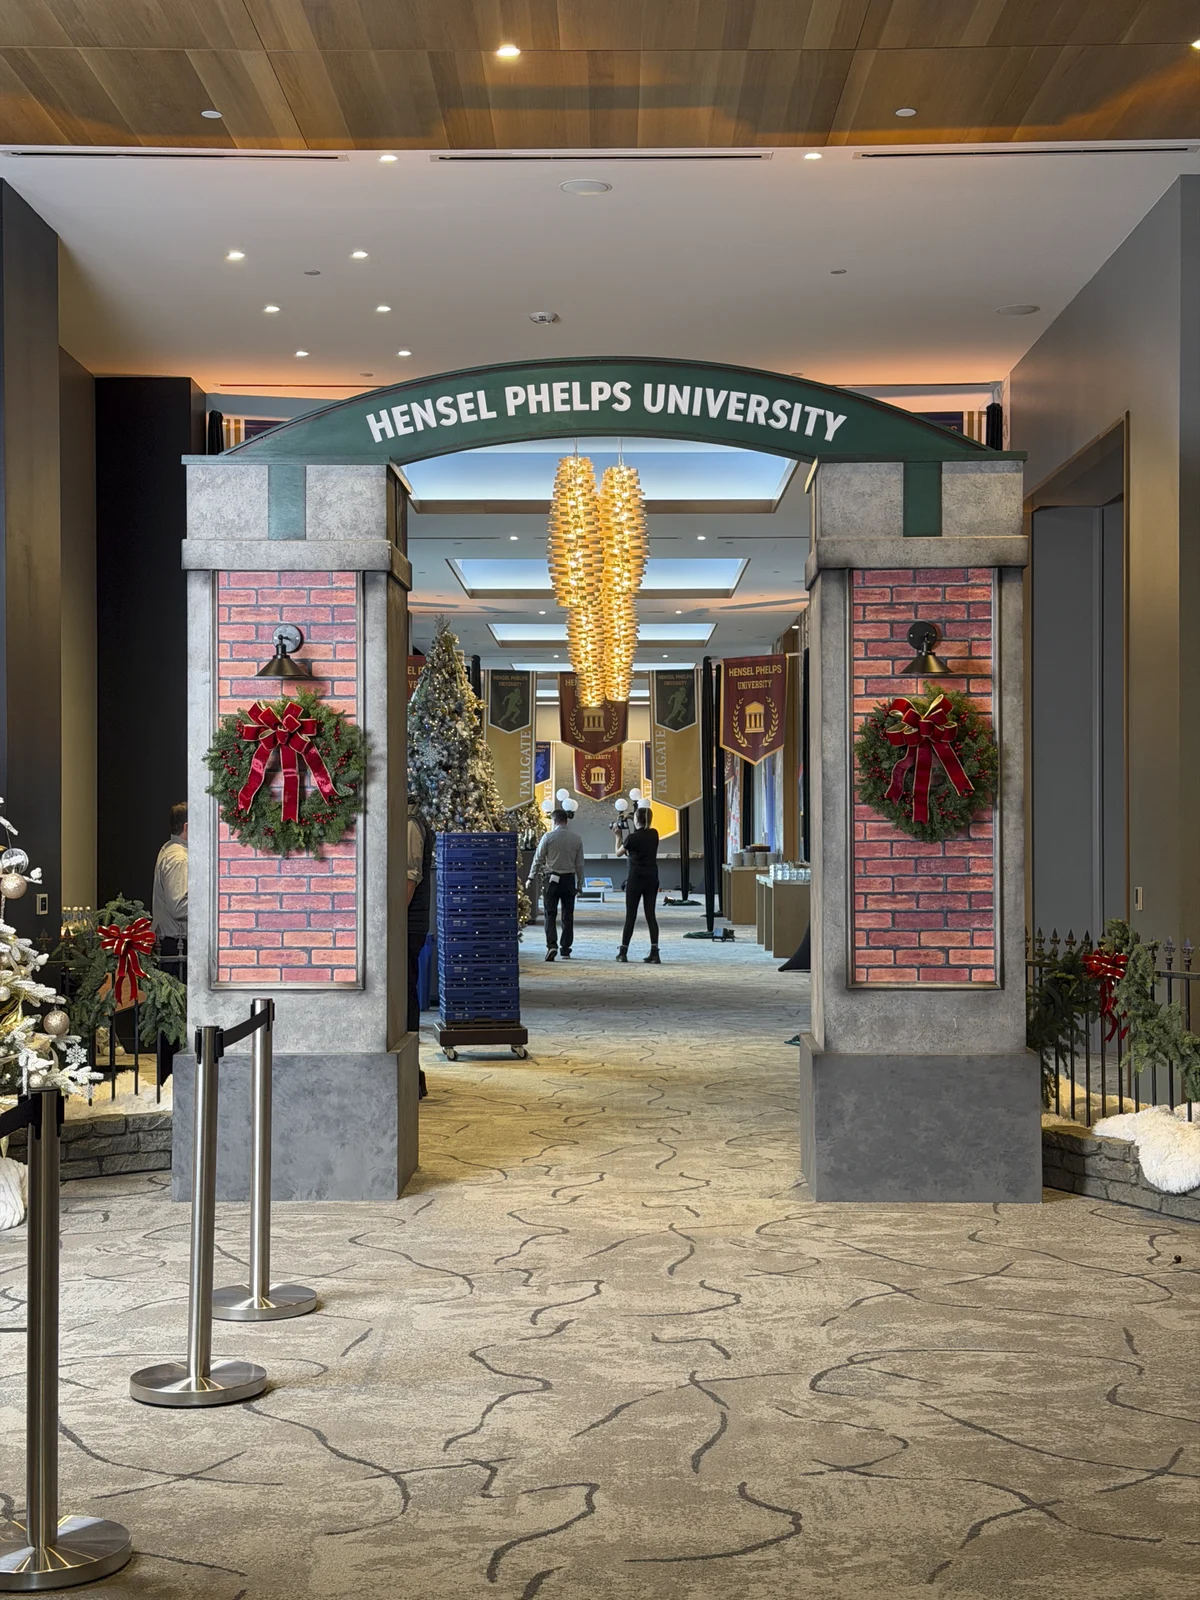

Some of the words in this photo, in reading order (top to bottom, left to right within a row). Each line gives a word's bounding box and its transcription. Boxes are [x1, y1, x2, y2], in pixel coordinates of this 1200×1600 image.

[366, 390, 497, 443] HENSEL
[505, 381, 632, 416] PHELPS
[643, 383, 848, 442] UNIVERSITY
[728, 667, 755, 677] HENSEL
[755, 664, 782, 675] PHELPS
[737, 679, 773, 690] UNIVERSITY
[520, 730, 531, 797] TAILGATE
[655, 729, 668, 796] TAILGATE
